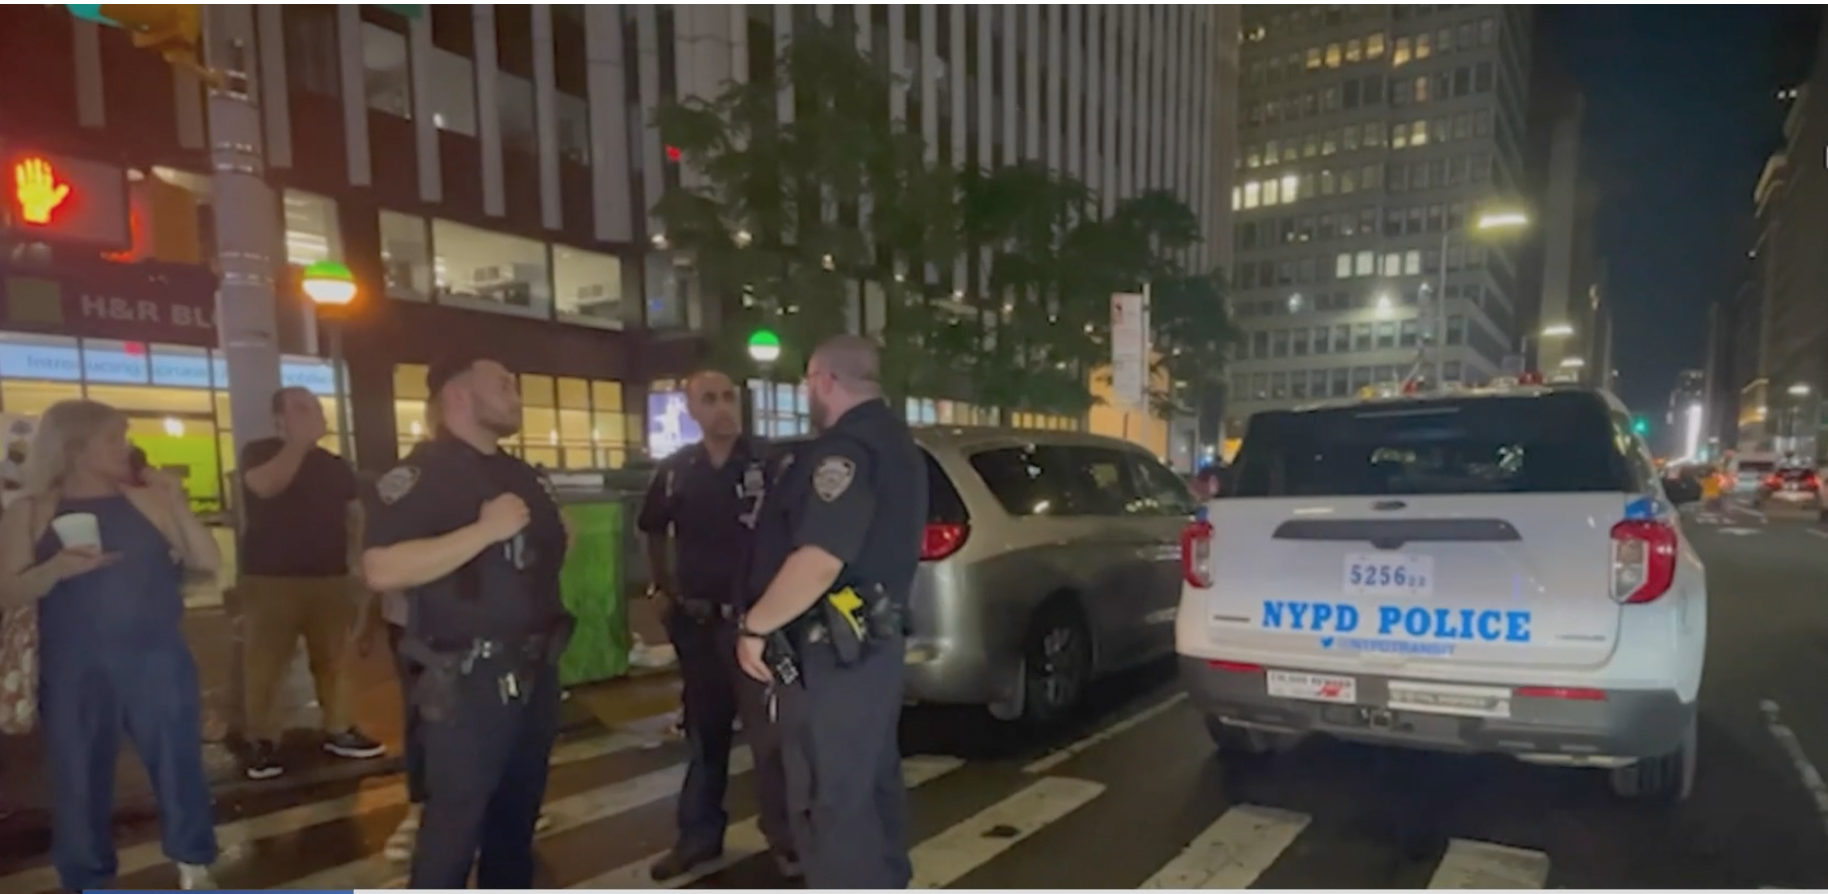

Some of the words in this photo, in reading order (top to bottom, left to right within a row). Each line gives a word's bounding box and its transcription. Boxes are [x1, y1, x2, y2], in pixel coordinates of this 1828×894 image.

[81, 293, 160, 323] H&R
[171, 303, 216, 329] BL
[1350, 563, 1406, 587] 5256
[1262, 600, 1359, 632] NYPD
[1378, 606, 1531, 642] POLICE
